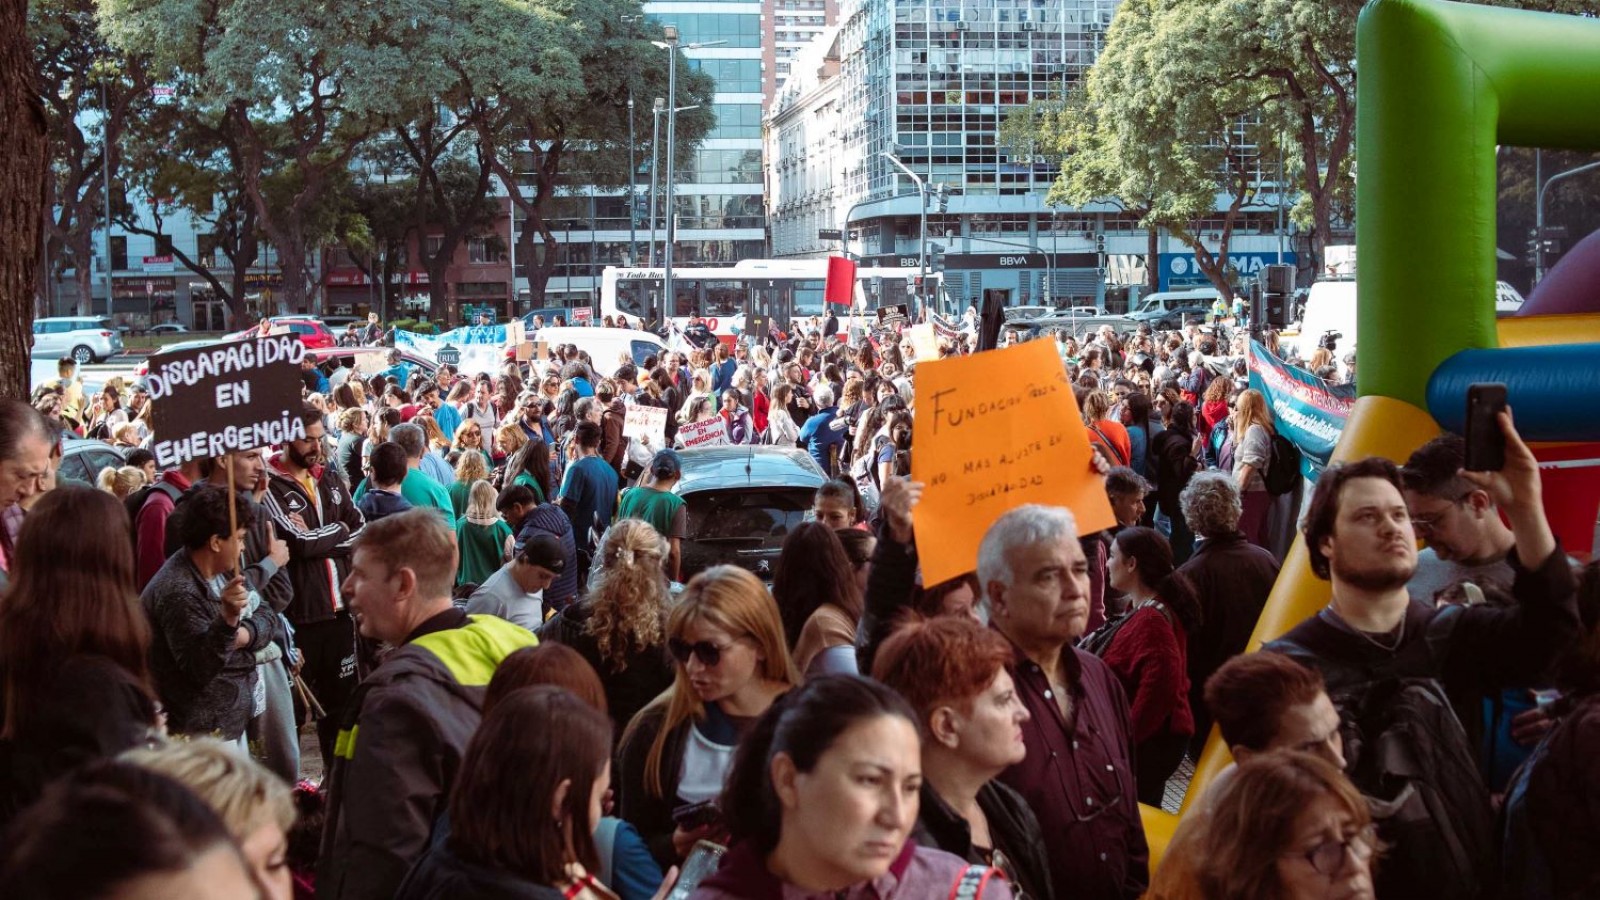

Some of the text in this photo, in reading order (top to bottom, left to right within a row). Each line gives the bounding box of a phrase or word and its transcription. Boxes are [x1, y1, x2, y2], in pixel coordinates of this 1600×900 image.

[1000, 256, 1027, 266] BBVA
[625, 270, 646, 278] Todo
[215, 380, 251, 409] EN
[963, 458, 991, 474] MAS
